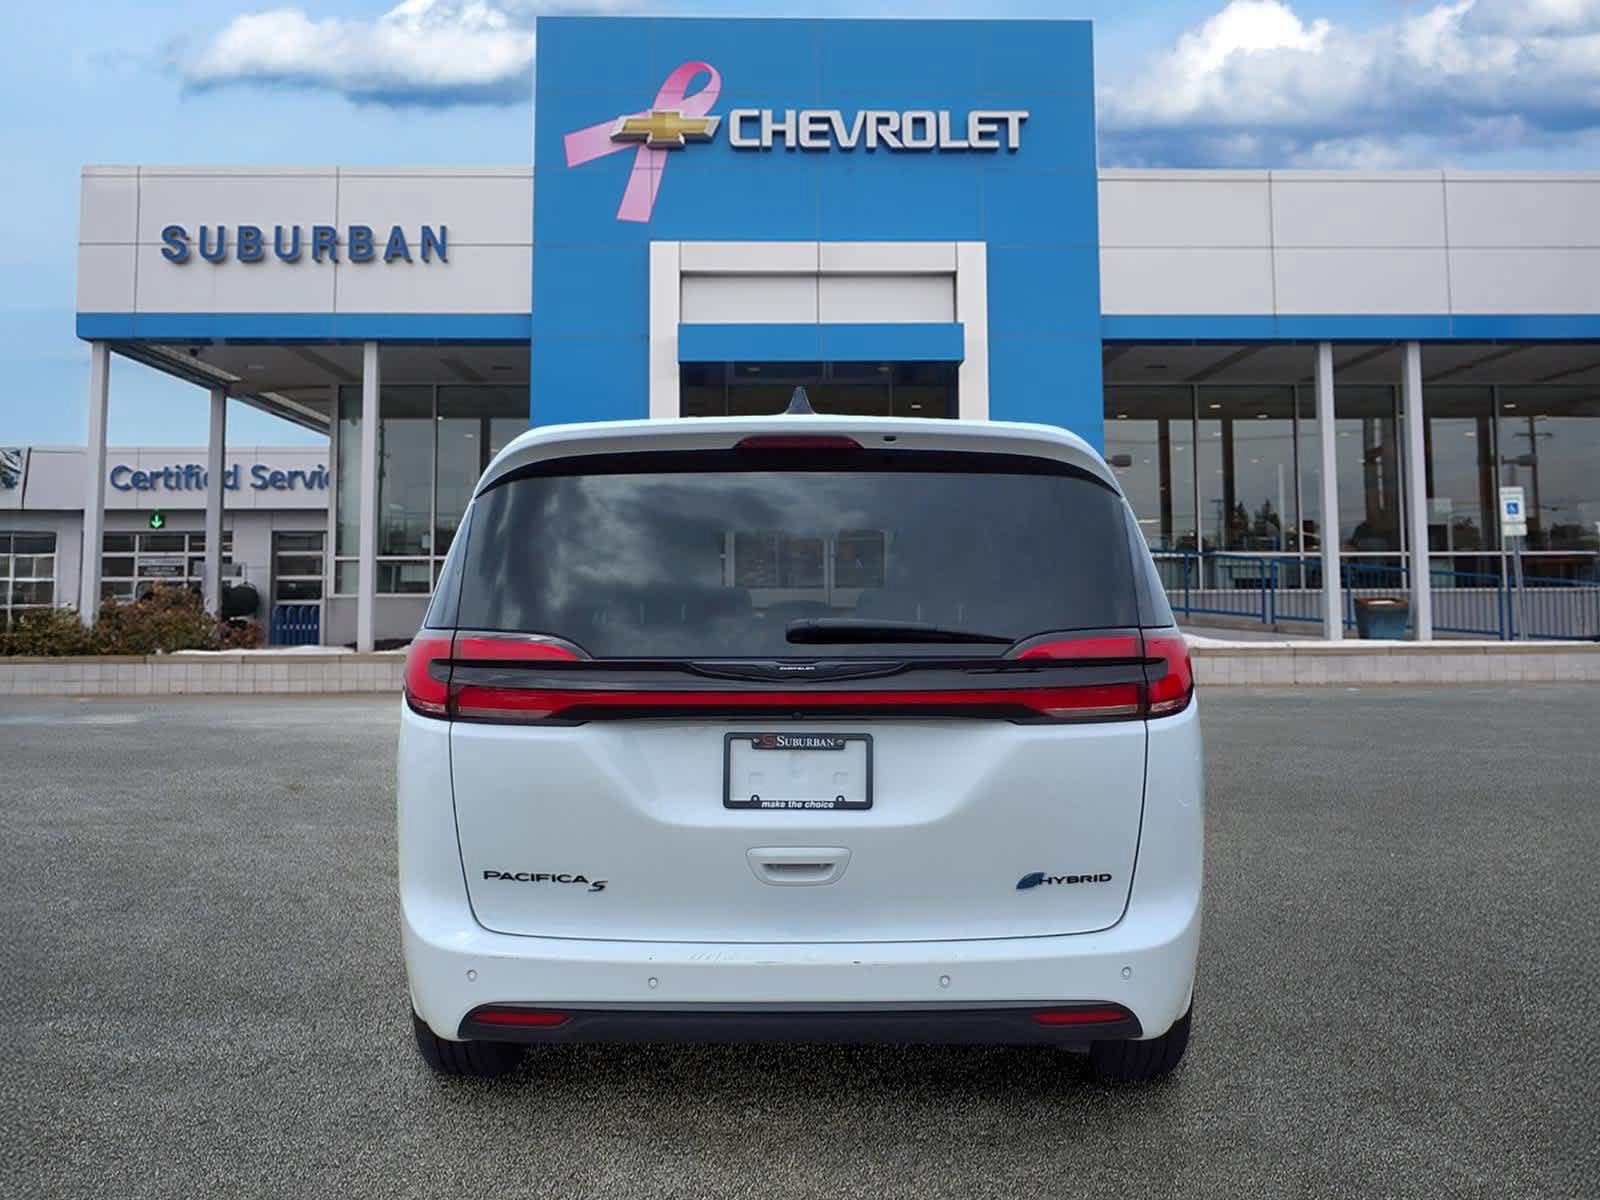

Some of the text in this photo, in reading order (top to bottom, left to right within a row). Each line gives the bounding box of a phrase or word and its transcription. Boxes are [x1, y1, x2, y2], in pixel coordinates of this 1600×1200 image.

[729, 108, 1030, 150] CHEVROLET
[160, 224, 449, 264] SUBURBAN
[110, 464, 330, 491] Certifid Servi
[761, 800, 835, 808] make the choice
[483, 870, 609, 892] PACIFICA S
[1038, 873, 1113, 885] HYBRID
